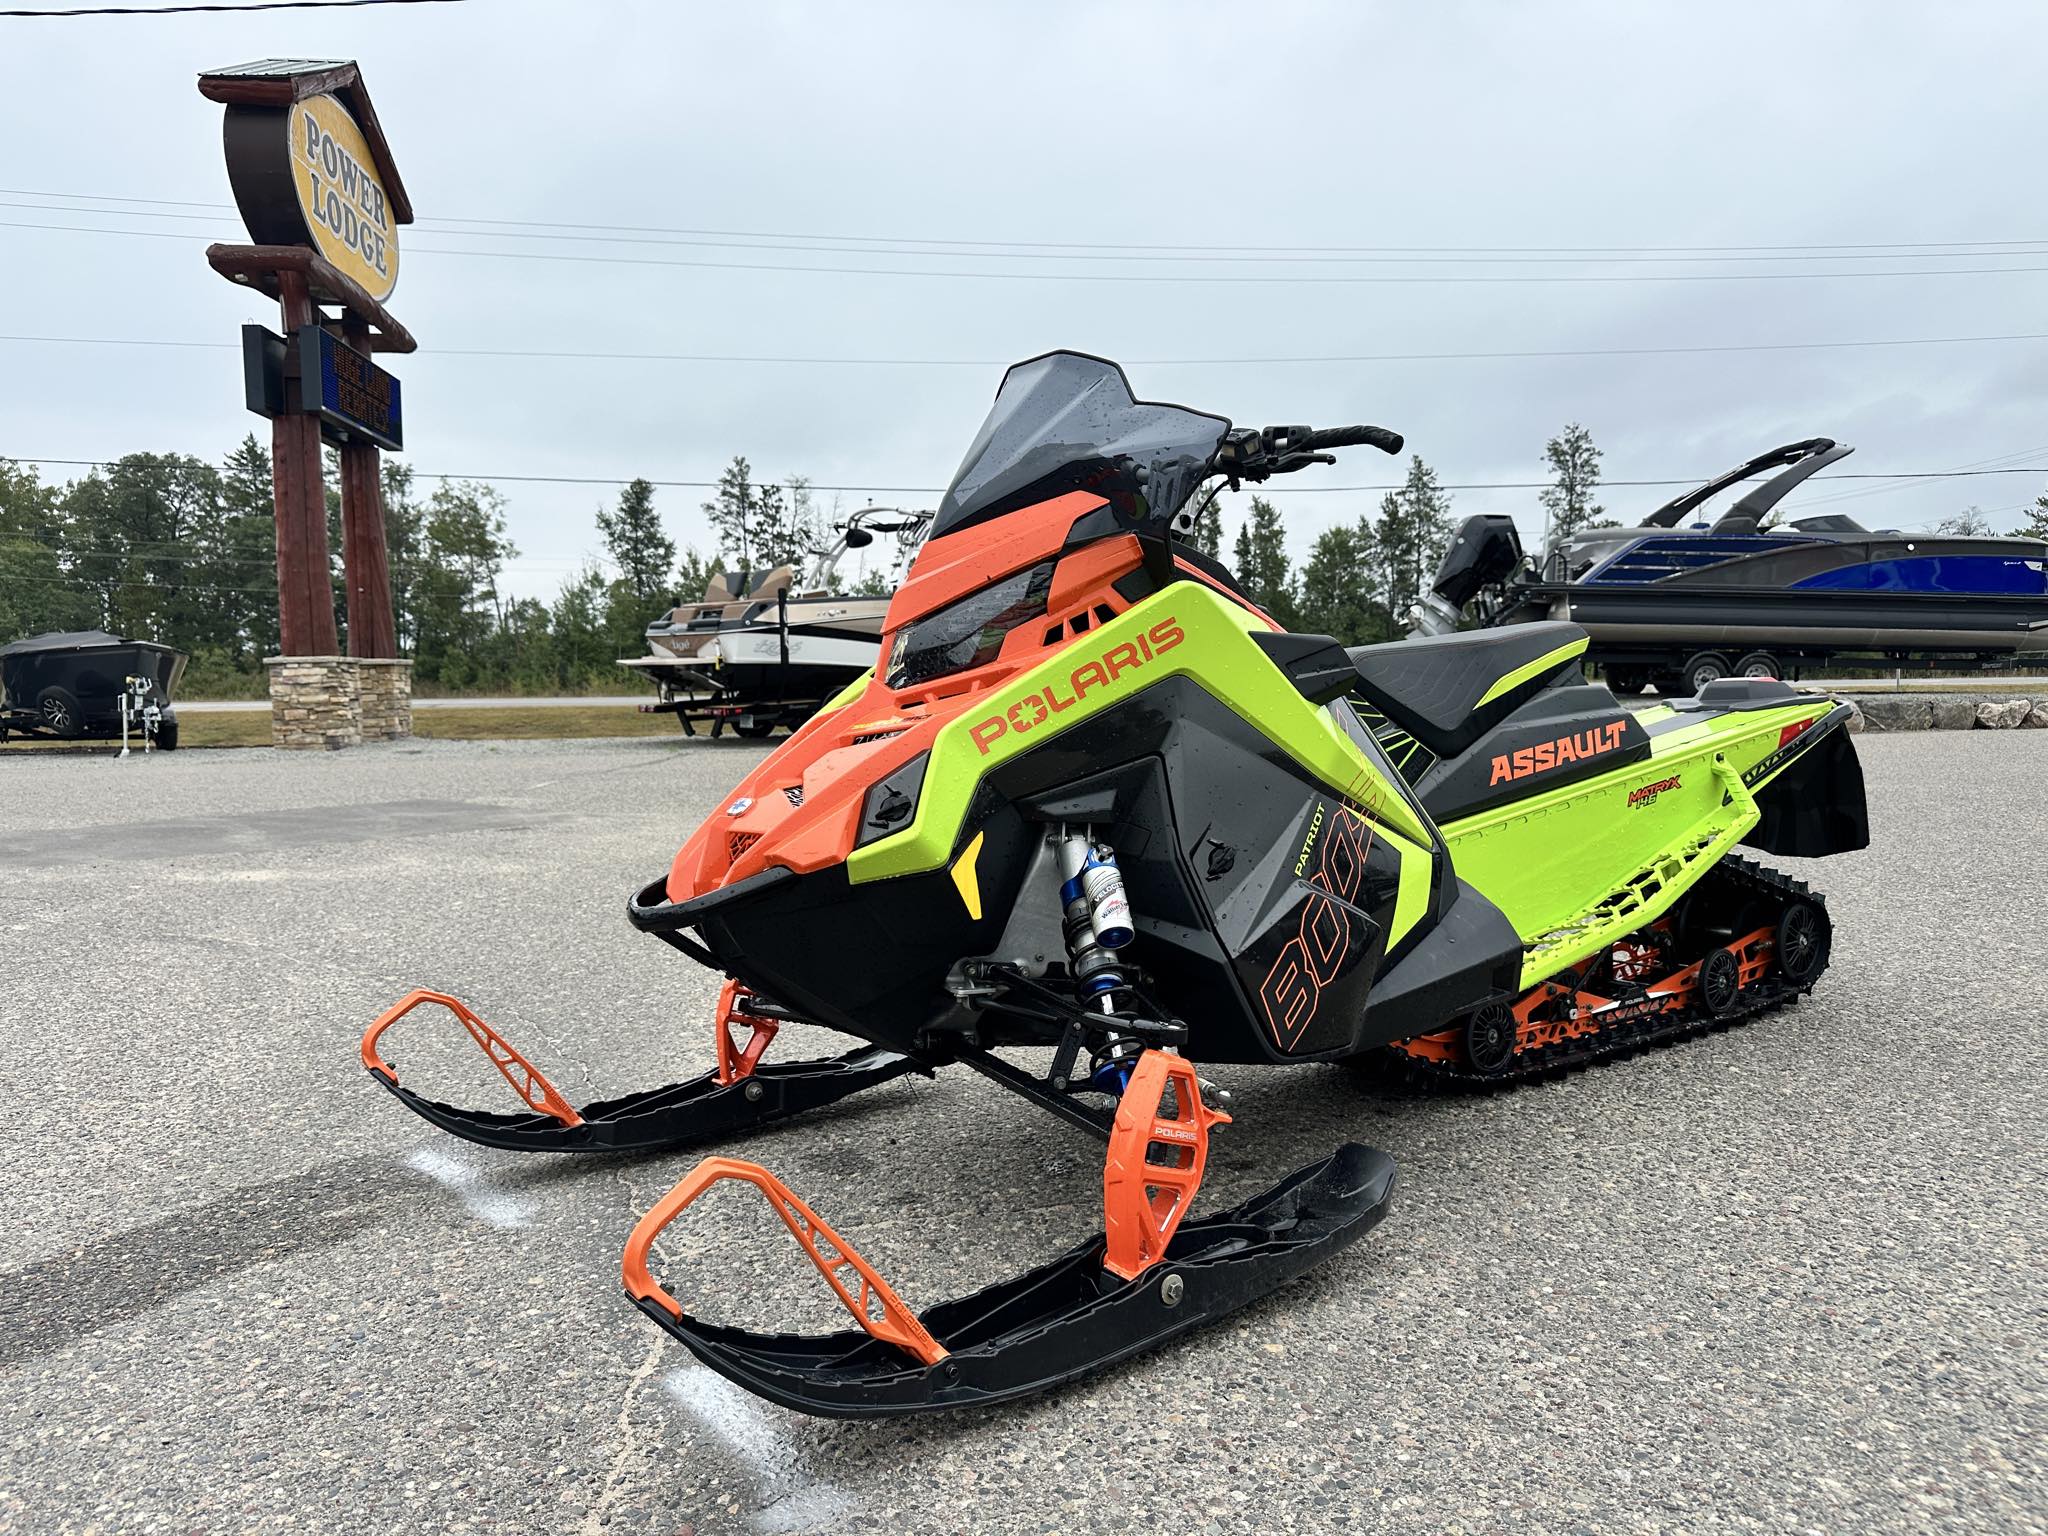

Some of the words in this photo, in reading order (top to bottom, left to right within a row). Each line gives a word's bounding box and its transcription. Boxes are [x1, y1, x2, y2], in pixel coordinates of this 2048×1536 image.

[304, 112, 387, 232] POWER
[310, 172, 387, 276] LODGE
[969, 616, 1184, 756] POLARIS
[1489, 720, 1626, 787] ASSAULT
[1627, 775, 1682, 807] MATRYX
[1294, 802, 1325, 877] PATRIOT
[1155, 1127, 1196, 1140] POLARIS
